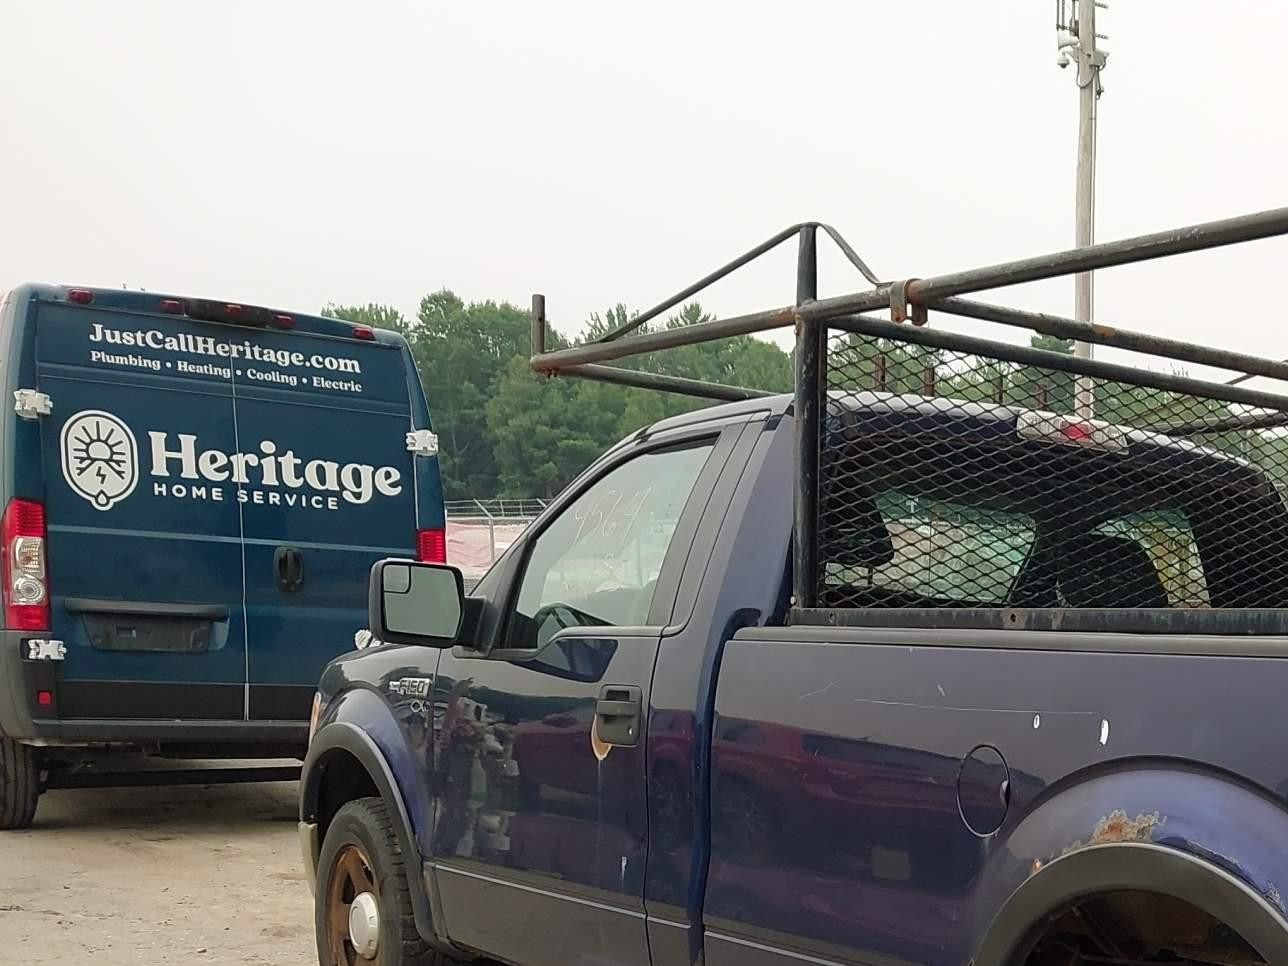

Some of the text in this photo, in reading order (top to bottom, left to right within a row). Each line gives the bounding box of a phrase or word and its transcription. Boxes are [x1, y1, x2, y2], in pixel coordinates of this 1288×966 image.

[89, 323, 361, 374] JustCallHeritage.com
[90, 350, 362, 393] Plumbing Heating Cooling Electric
[148, 431, 402, 504] Heritage
[153, 482, 339, 510] HOME SERVICE
